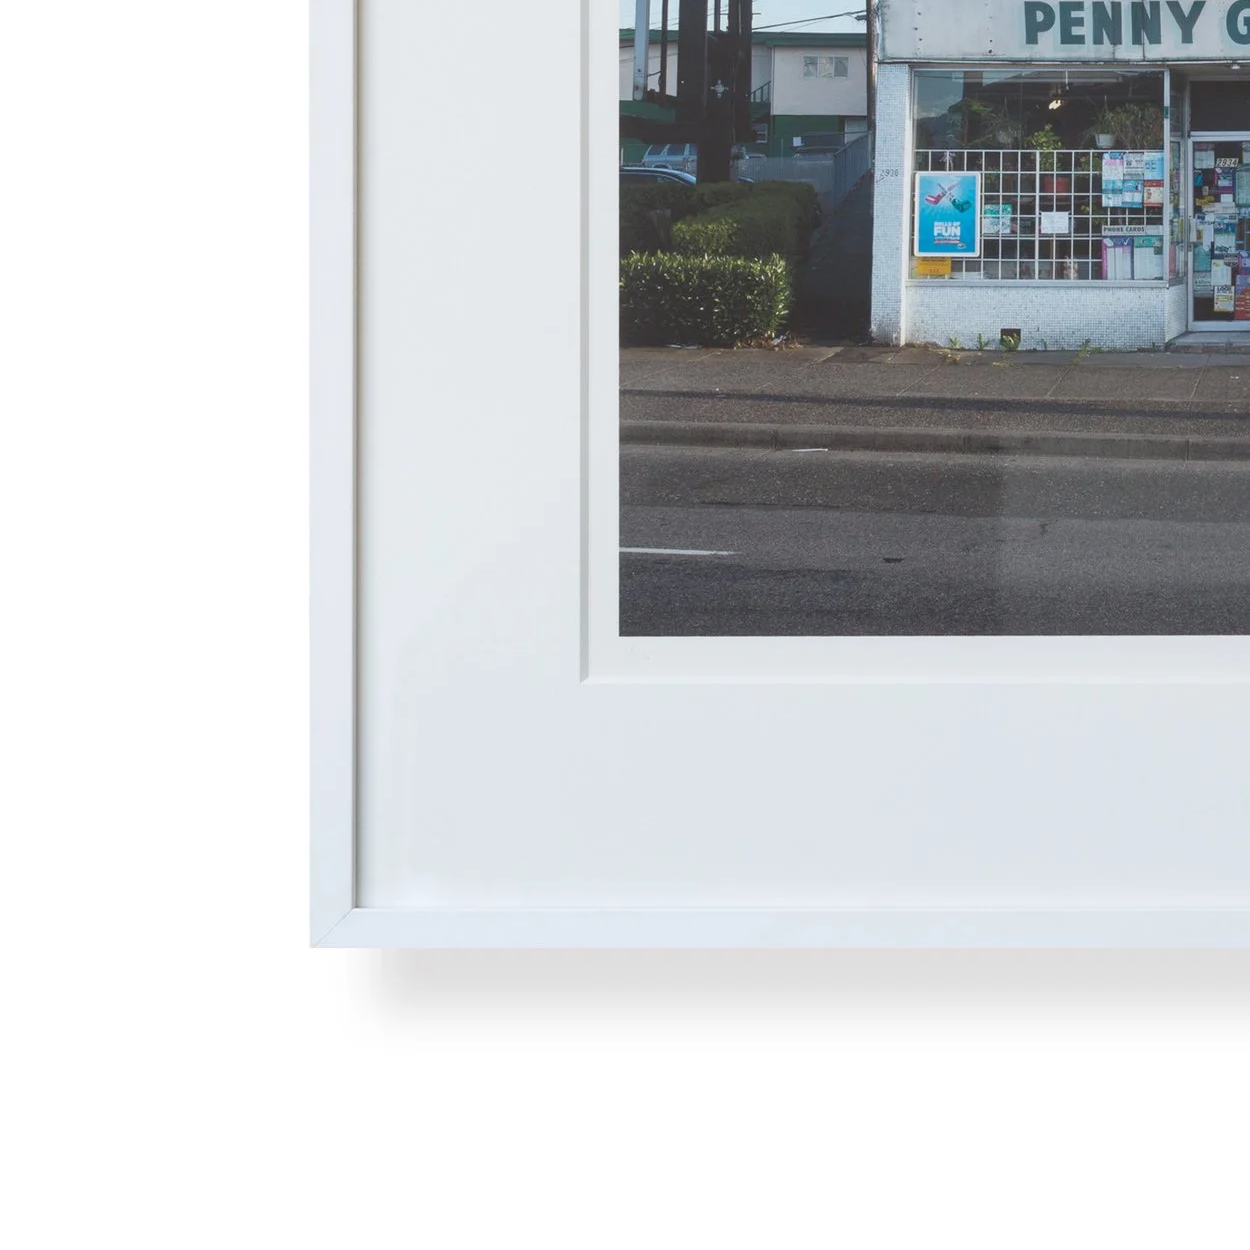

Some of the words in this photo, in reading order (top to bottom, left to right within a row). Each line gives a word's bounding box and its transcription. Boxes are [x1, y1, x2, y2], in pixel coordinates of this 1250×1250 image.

[1024, 0, 1206, 45] PENNY
[1216, 158, 1238, 167] 2934
[933, 225, 961, 237] FUN
